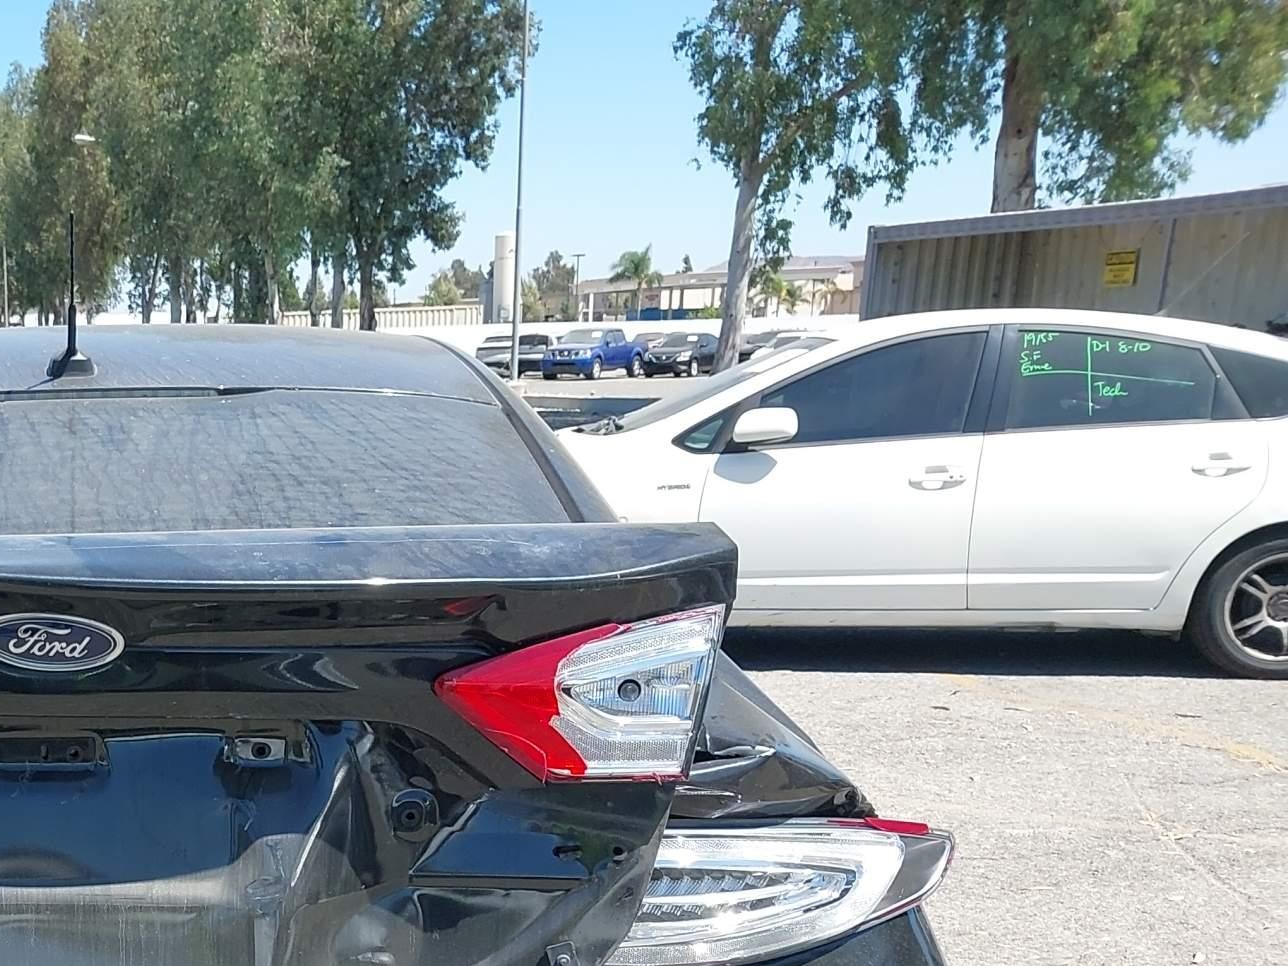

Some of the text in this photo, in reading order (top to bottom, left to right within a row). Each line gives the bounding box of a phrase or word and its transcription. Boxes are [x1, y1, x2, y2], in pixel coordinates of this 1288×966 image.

[1118, 341, 1151, 353] 8-10
[1094, 381, 1128, 396] Tech
[8, 624, 91, 659] Ford
